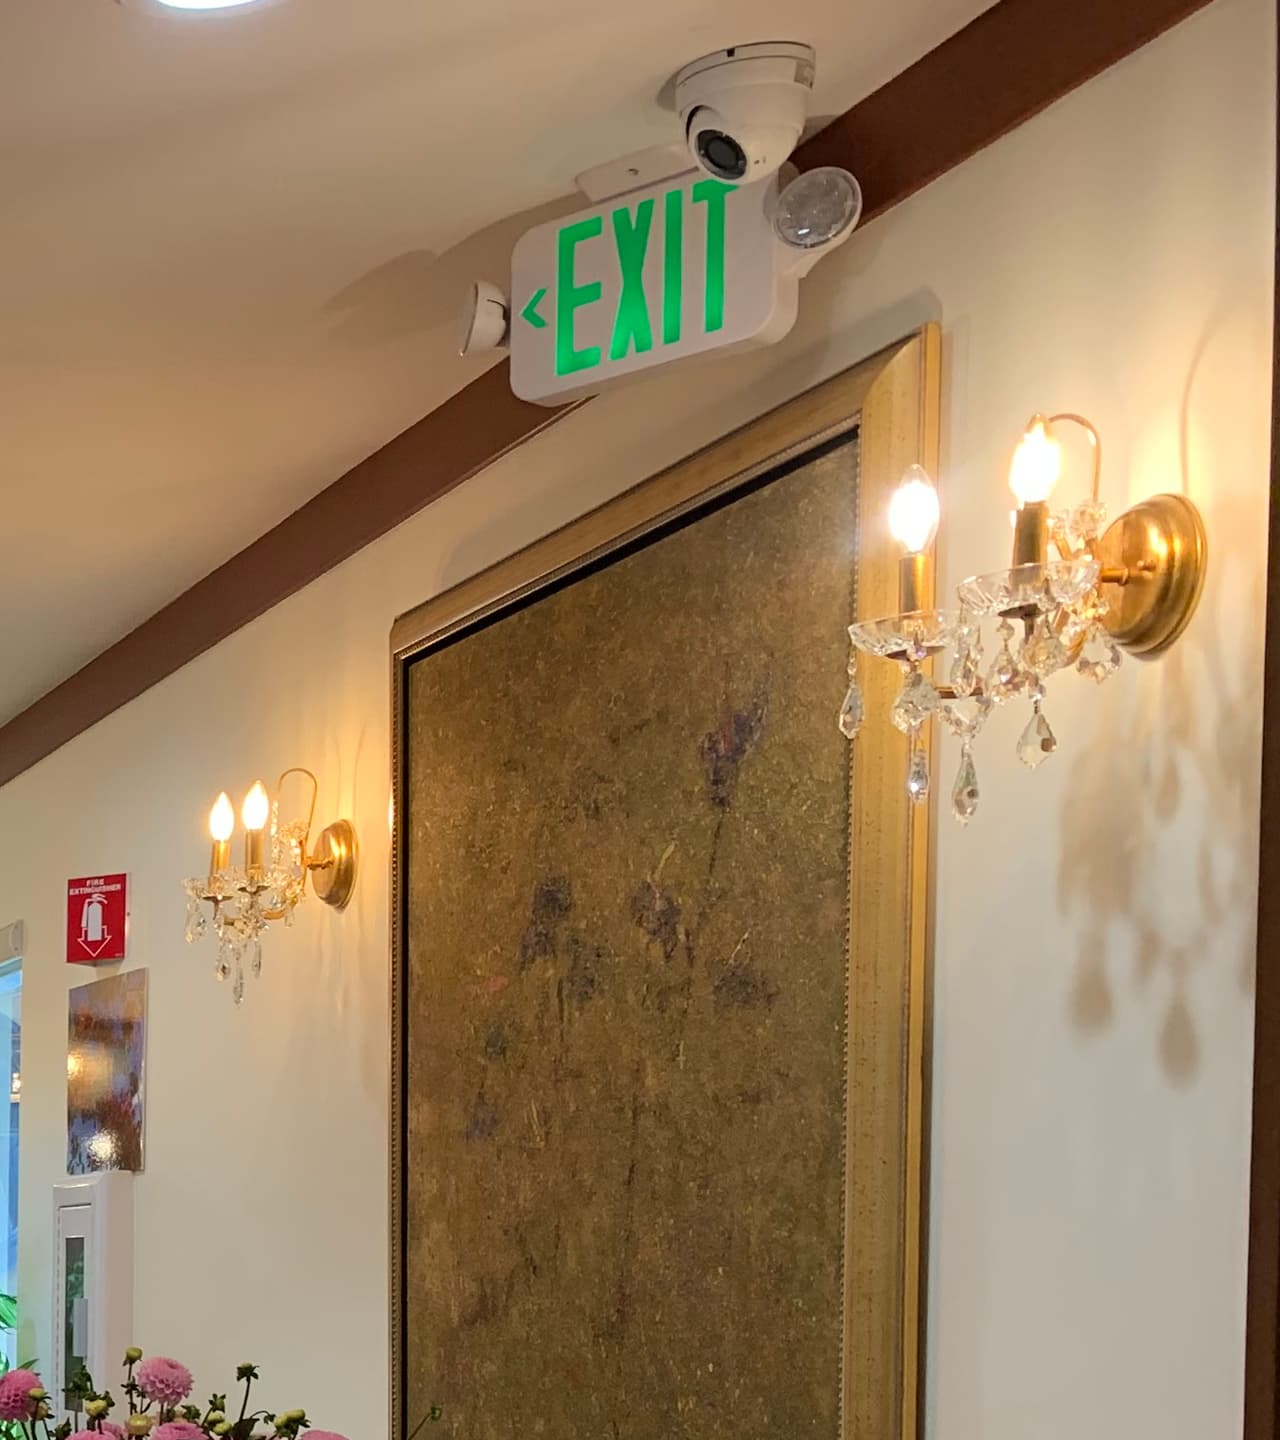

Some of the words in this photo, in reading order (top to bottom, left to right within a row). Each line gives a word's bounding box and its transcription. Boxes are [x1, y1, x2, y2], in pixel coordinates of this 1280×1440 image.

[555, 179, 739, 376] EXIT
[86, 879, 104, 887] FIRE
[69, 884, 121, 895] EXTINGUISHER
